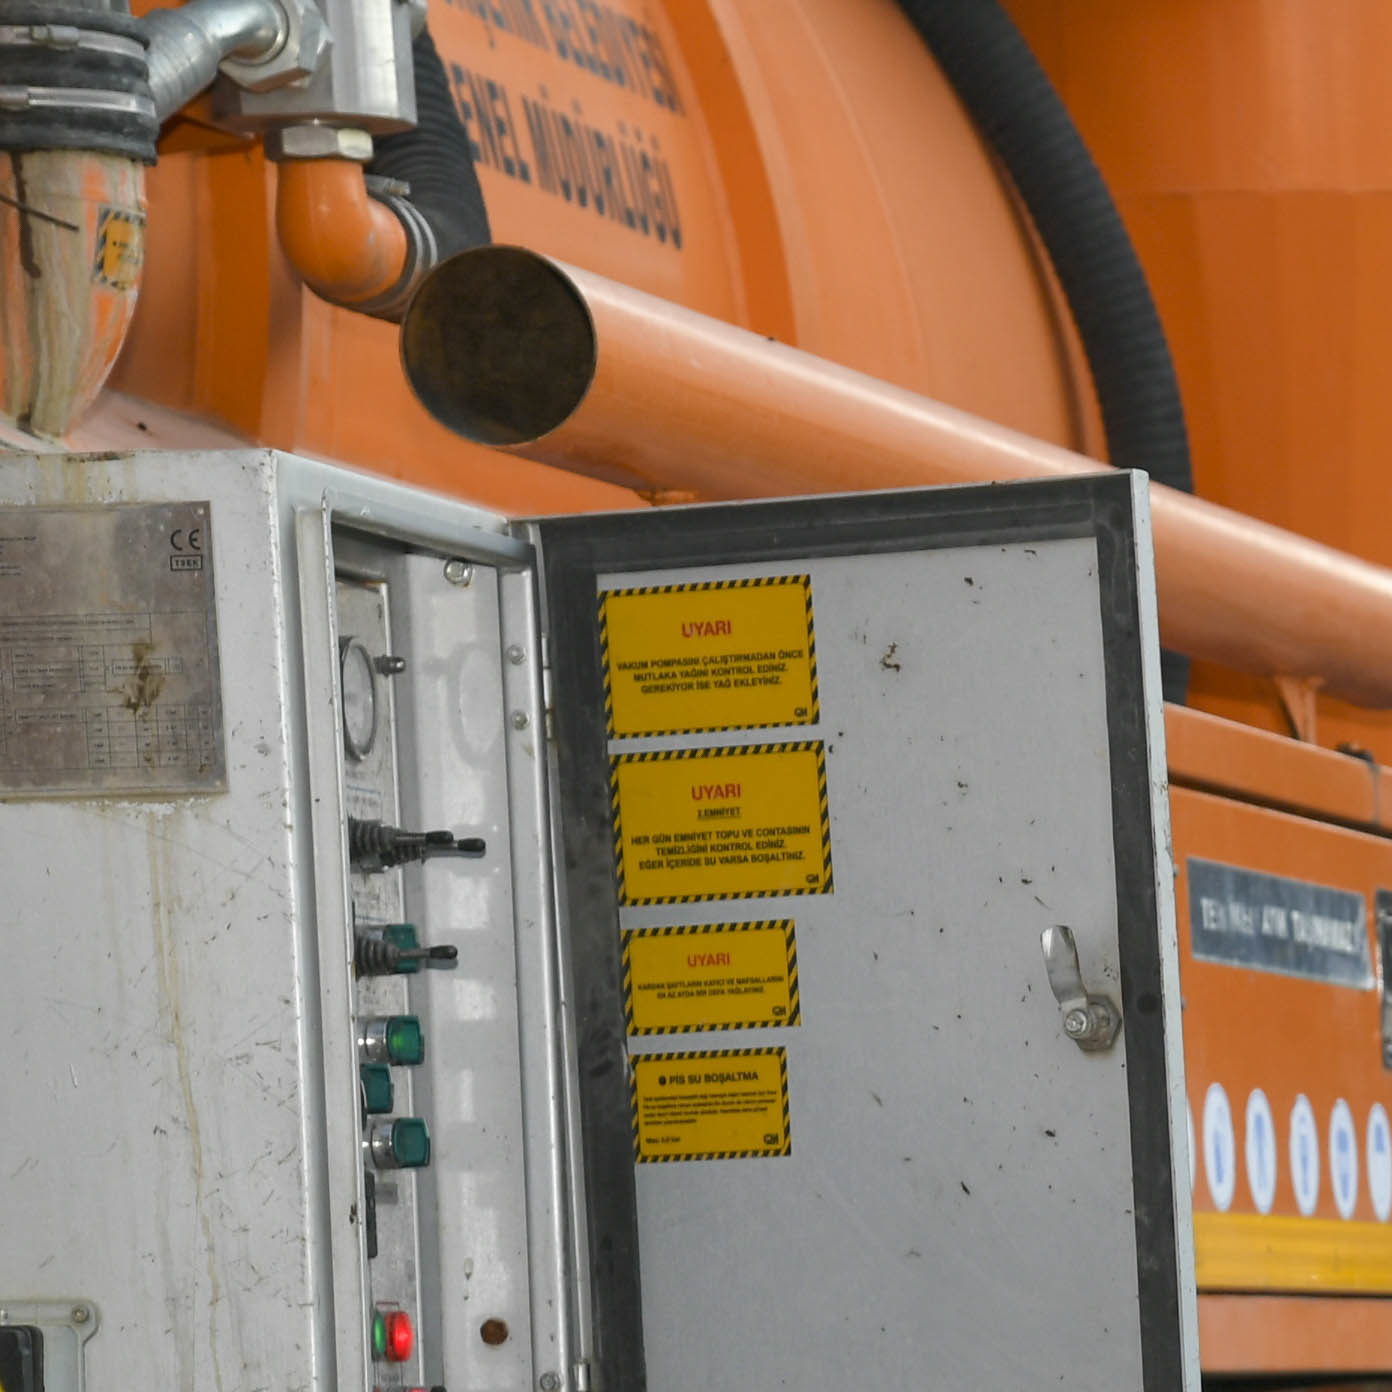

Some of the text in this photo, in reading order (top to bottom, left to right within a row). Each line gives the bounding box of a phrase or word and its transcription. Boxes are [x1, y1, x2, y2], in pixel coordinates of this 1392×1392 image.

[682, 620, 732, 638] UYARI
[778, 649, 804, 660] ÖNCE
[633, 671, 677, 682] MUTLAKA
[711, 665, 754, 677] KONTROL
[691, 783, 741, 801] UYARI
[631, 836, 650, 845] HER
[652, 833, 672, 844] GÜN
[715, 829, 740, 840] TOPU
[742, 828, 753, 838] VE
[710, 842, 753, 853] KONTROL
[719, 854, 749, 865] VARSA
[687, 952, 730, 967] UYARI
[704, 1071, 759, 1084] BOŞALTMA
